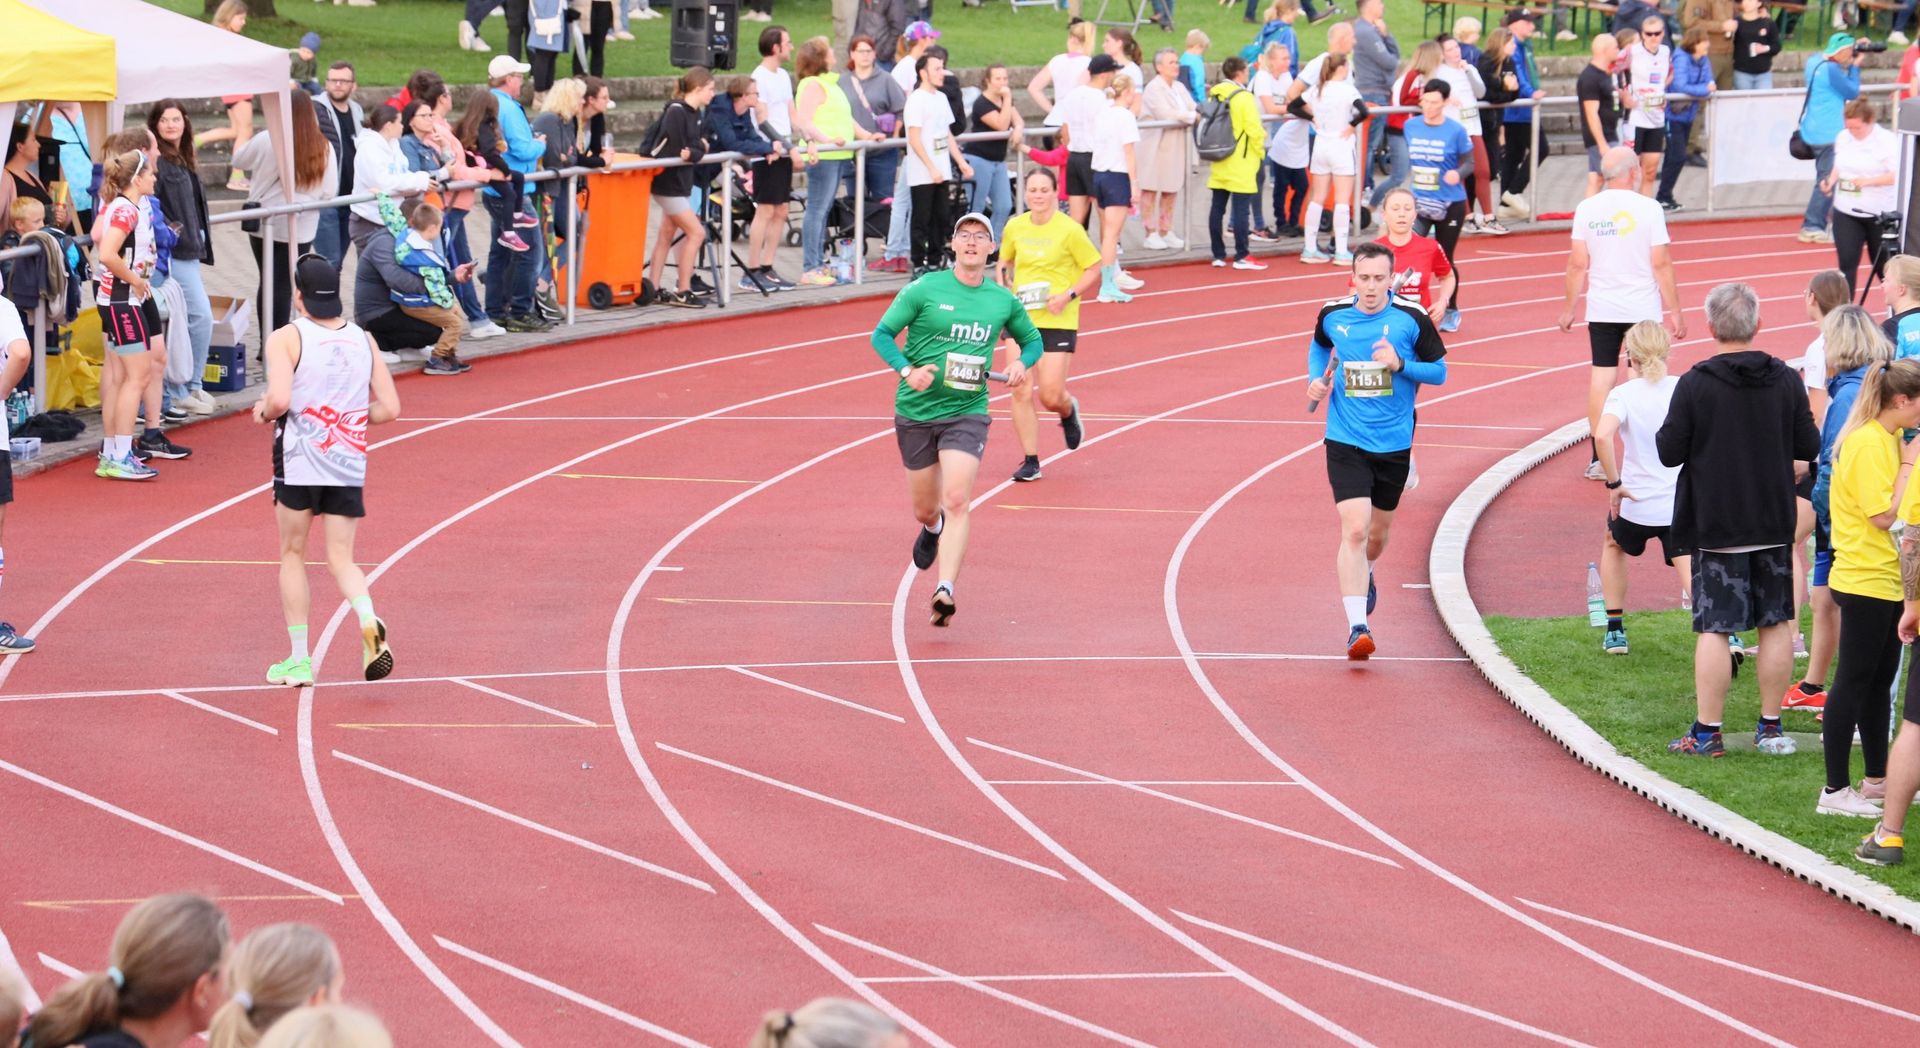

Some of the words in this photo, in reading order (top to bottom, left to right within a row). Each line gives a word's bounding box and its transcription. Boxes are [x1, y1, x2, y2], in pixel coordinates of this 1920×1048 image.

[950, 321, 992, 342] mbi
[951, 366, 981, 381] 449.3
[1350, 373, 1383, 387] 115.1
